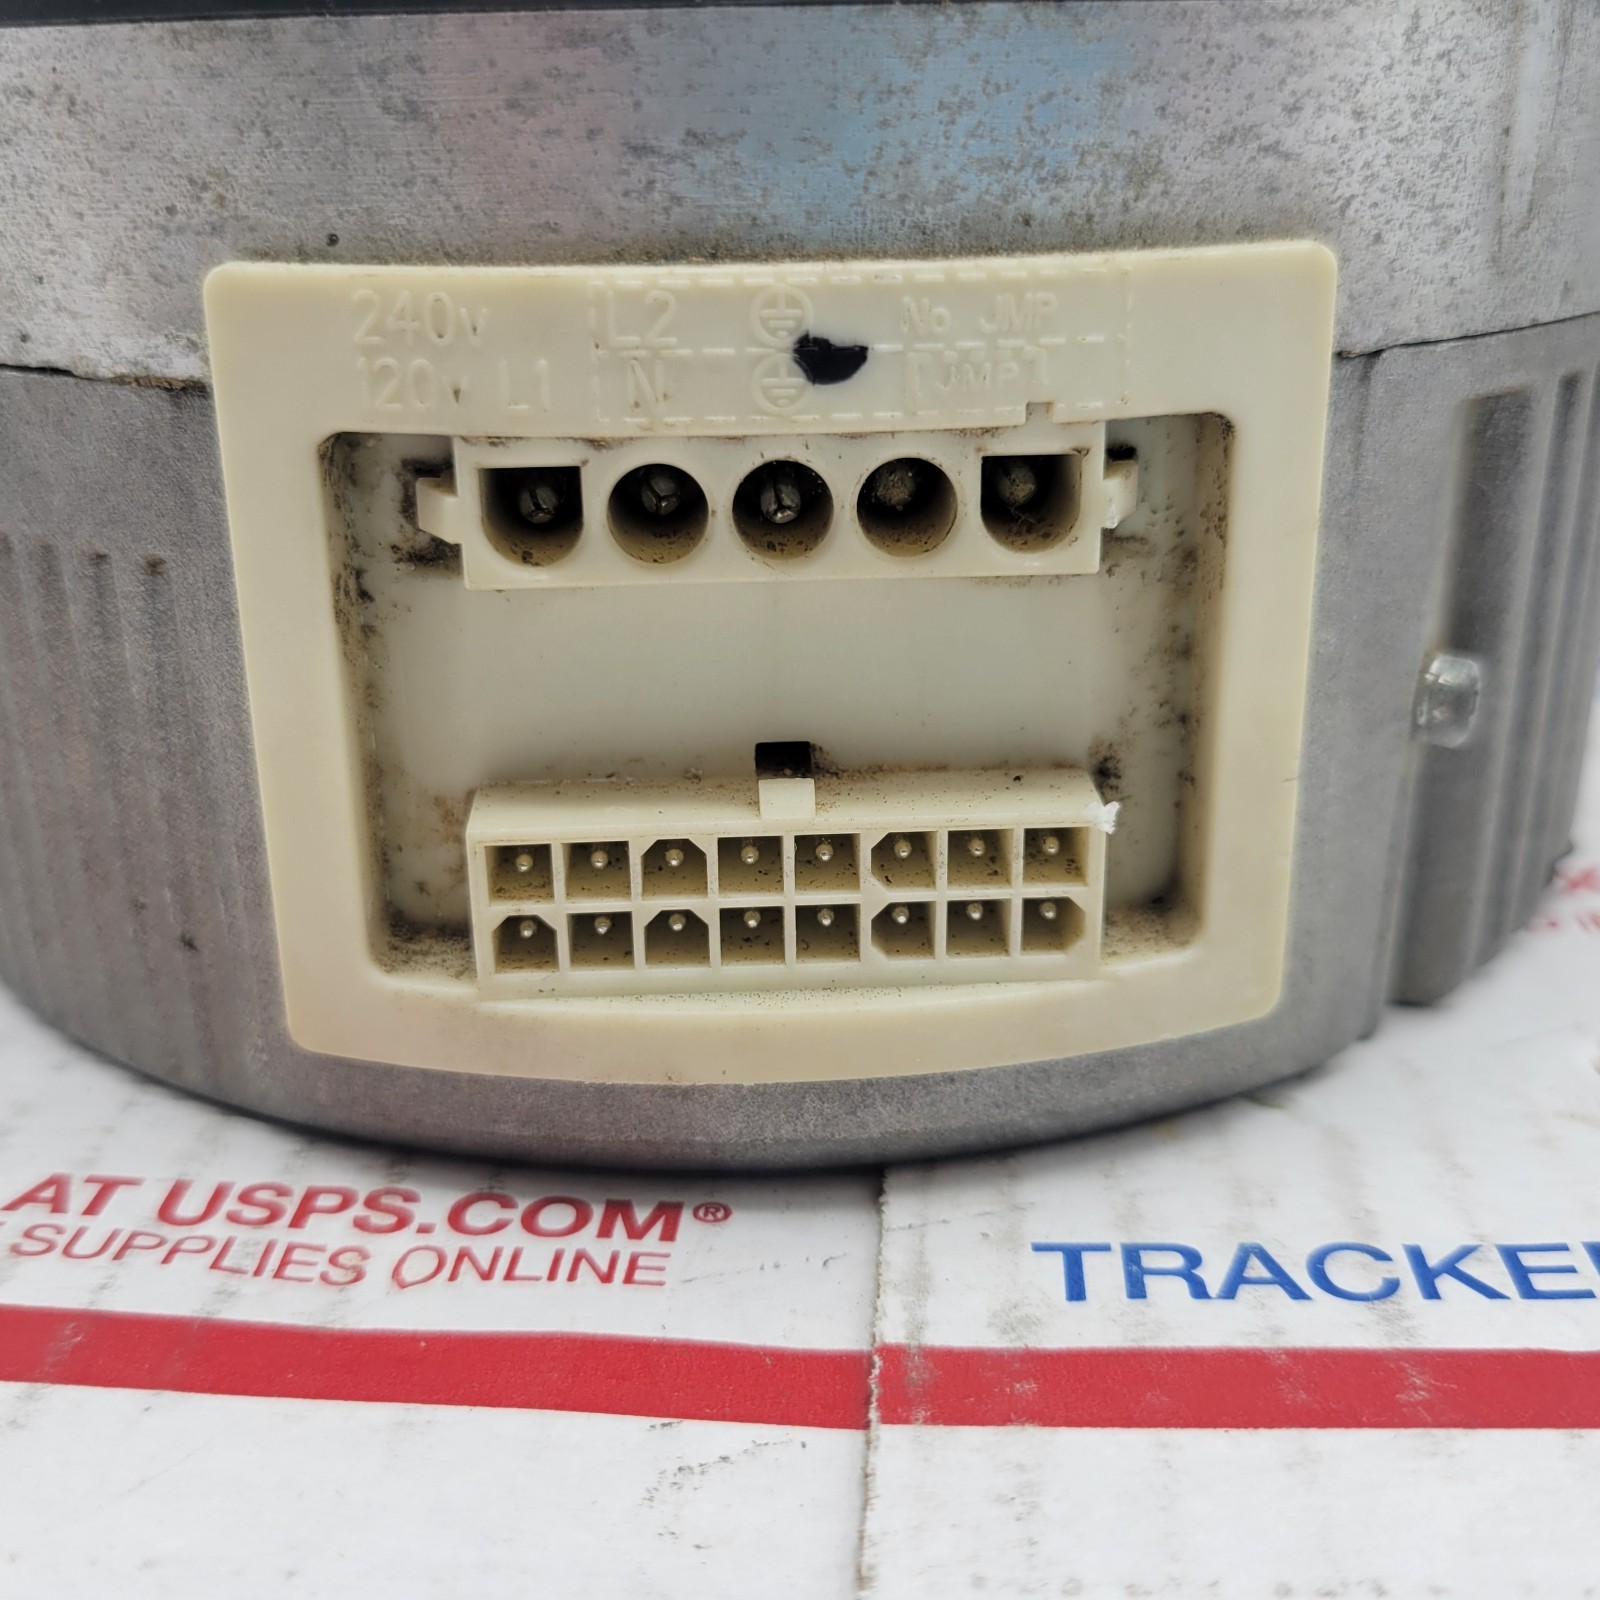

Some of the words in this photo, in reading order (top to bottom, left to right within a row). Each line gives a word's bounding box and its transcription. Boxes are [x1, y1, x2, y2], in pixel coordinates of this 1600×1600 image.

[606, 290, 677, 348] L2
[979, 293, 1058, 333] JMP
[628, 357, 667, 410] N
[933, 362, 1020, 392] JMP
[1, 1172, 147, 1217] AT
[10, 1222, 372, 1286] SUPPLIES
[391, 1244, 672, 1289] ONLINE
[1031, 1241, 1600, 1301] TRACKE
